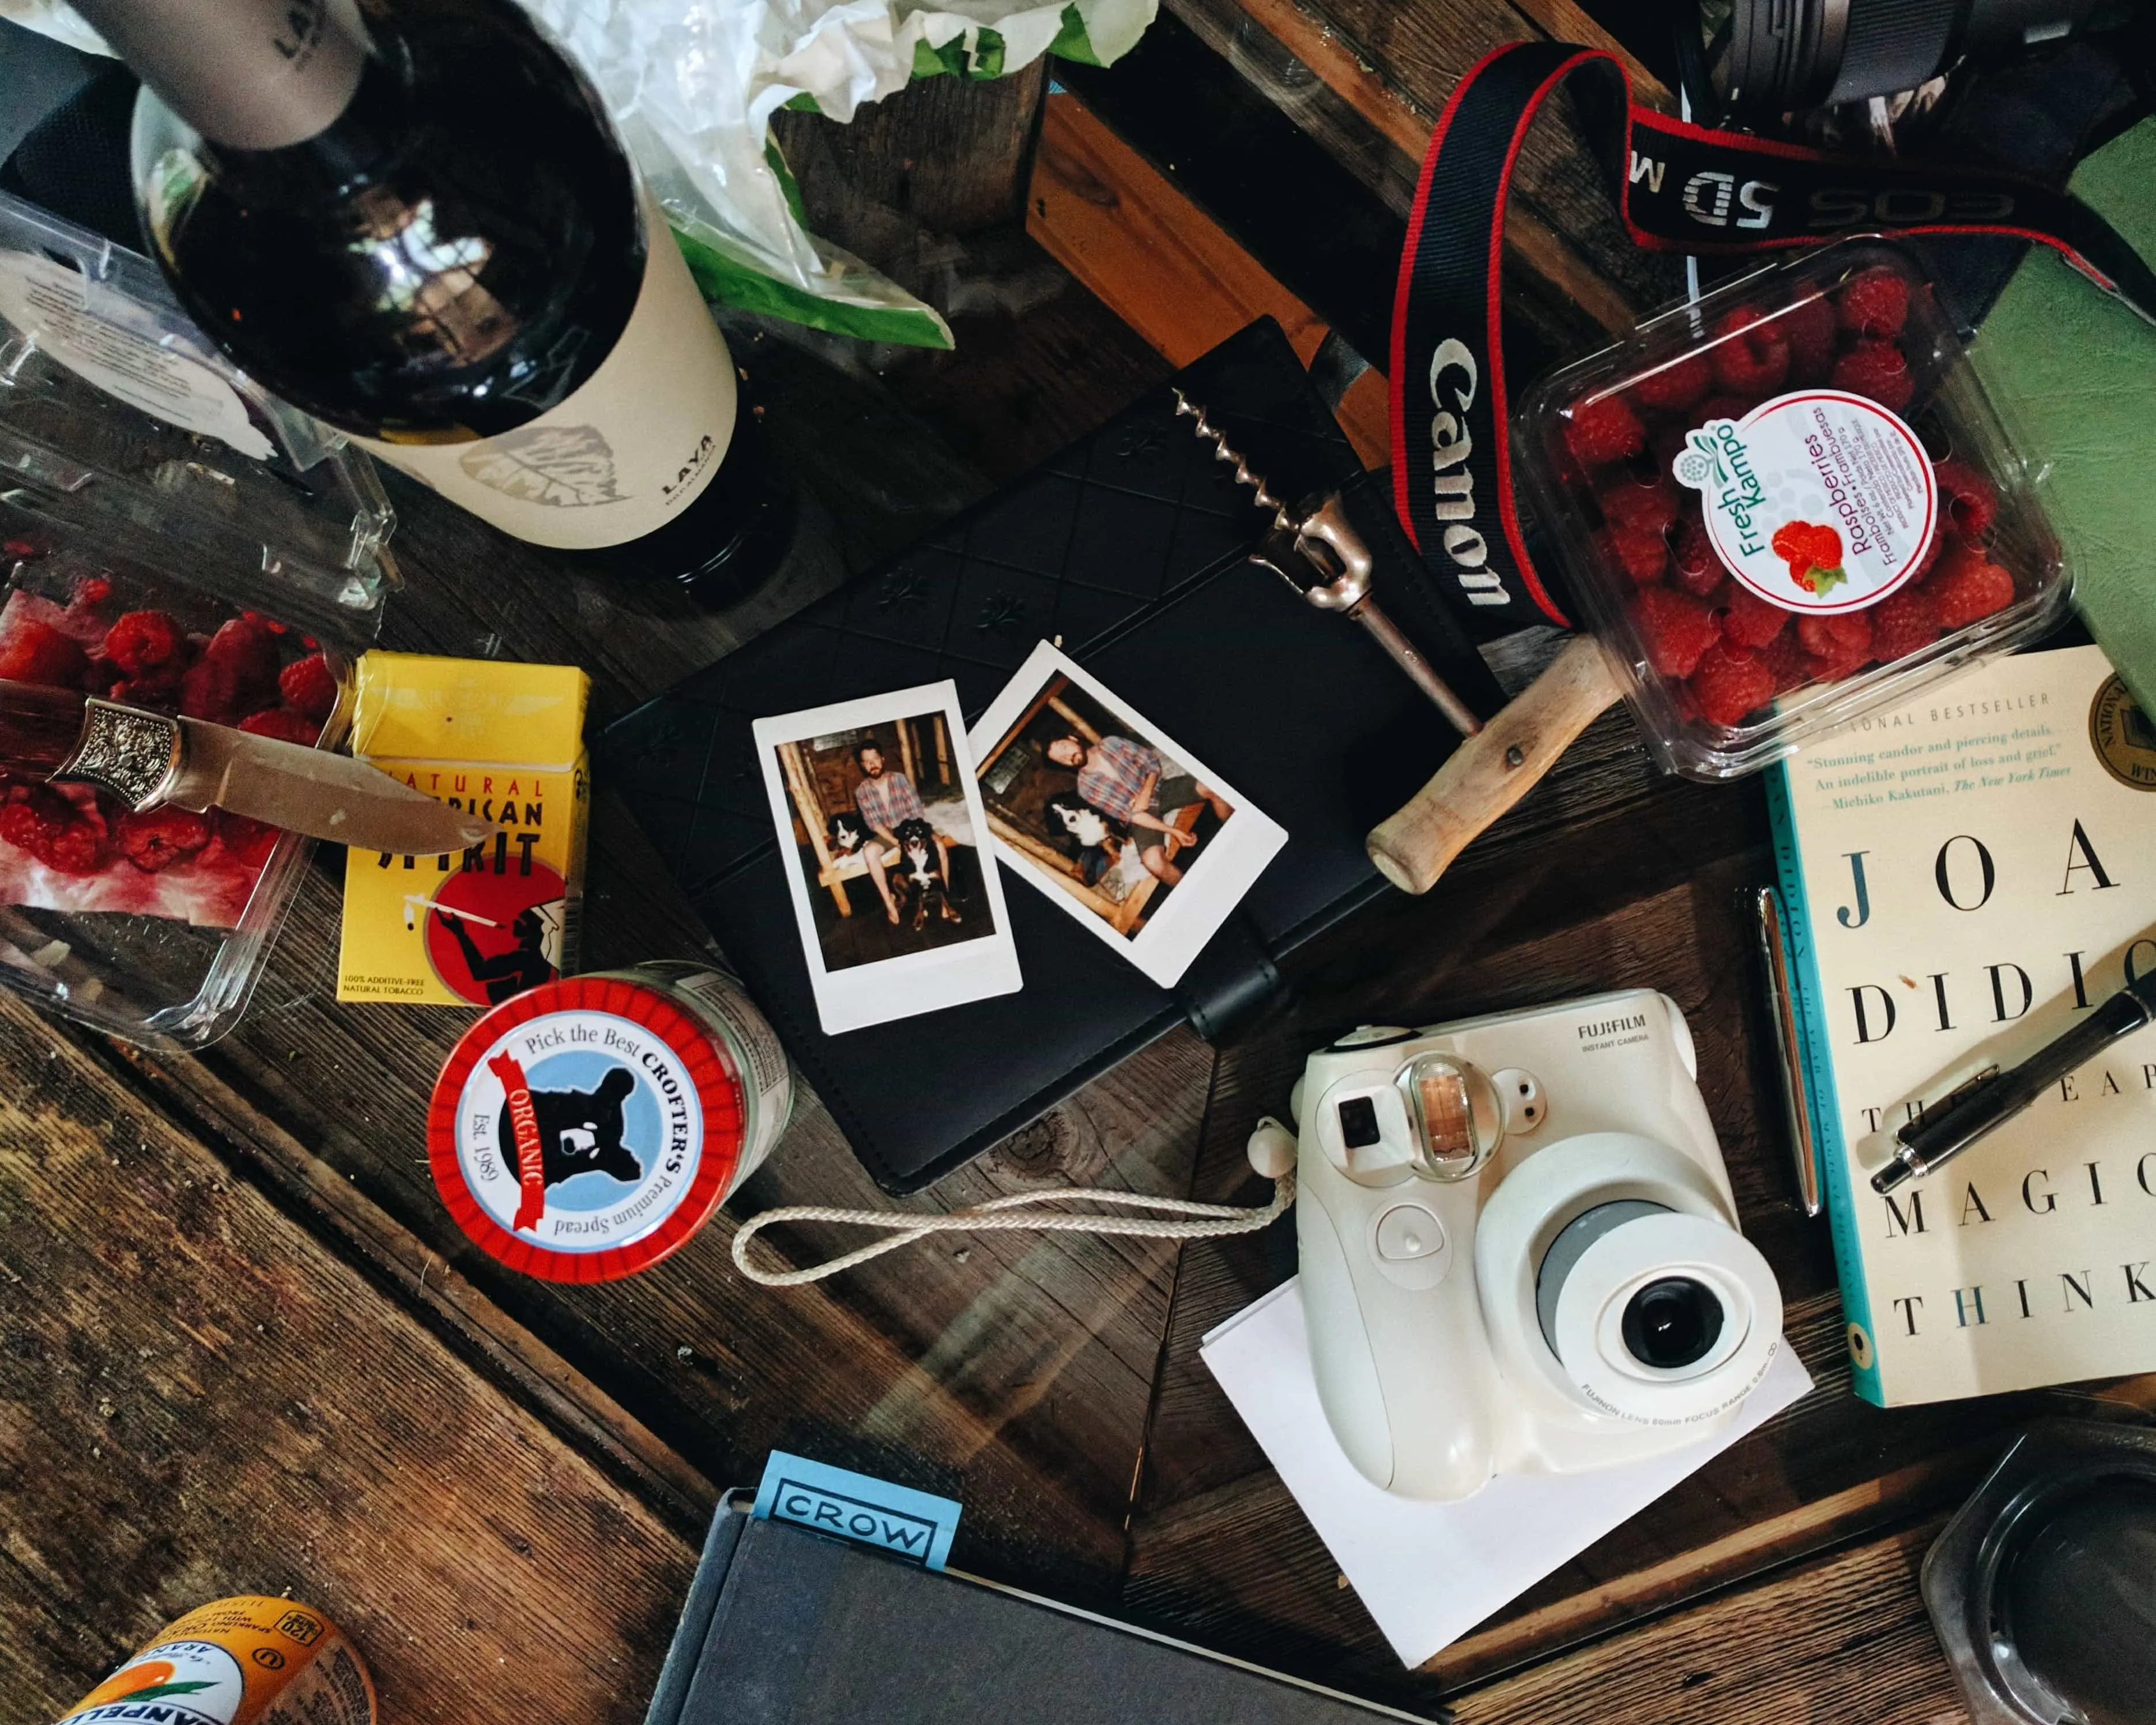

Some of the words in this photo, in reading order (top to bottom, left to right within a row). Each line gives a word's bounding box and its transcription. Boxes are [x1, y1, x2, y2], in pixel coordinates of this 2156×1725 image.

[1683, 171, 1780, 229] 5D
[662, 434, 713, 495] LAYA
[1813, 407, 1855, 487] Frambuesas
[1430, 337, 1511, 605] Canon
[1717, 424, 1767, 511] Kampo
[1804, 434, 1872, 556] Raspberries
[1717, 488, 1766, 557] Fresh
[1855, 494, 1897, 566] Framboises
[1930, 692, 2051, 722] BESTSELLER
[1879, 744, 1923, 760] candor
[1927, 739, 1952, 753] and
[1955, 732, 2008, 752] piercing
[388, 770, 542, 797] ATURAL
[1815, 779, 1833, 792] An
[1838, 771, 1895, 787] indelible
[1901, 763, 1949, 781] portrait
[1953, 759, 1967, 771] of
[1970, 754, 1995, 766] loss
[1999, 748, 2022, 762] and
[1889, 784, 1950, 802] Kakutani,
[1954, 779, 1976, 792] The
[1980, 775, 2003, 788] New
[2008, 771, 2036, 784] York
[2038, 766, 2072, 779] Times
[431, 796, 543, 826] ICAN
[378, 833, 541, 876] RIT
[343, 985, 380, 993] NATURAL
[384, 986, 424, 996] TOBACCO
[344, 974, 365, 984] 100%
[367, 976, 425, 986] ADDITIVE-FREE
[524, 1027, 566, 1055] Pick
[570, 1023, 598, 1042] the
[601, 1027, 642, 1059] Best
[1577, 1014, 1646, 1039] FUJIFILM
[1582, 1039, 1616, 1053] INSTANT
[1617, 1033, 1649, 1046] CAMERA
[473, 1113, 491, 1142] Est.
[640, 1051, 688, 1175] CROFTER'S
[509, 1087, 544, 1188] ORGANIC
[473, 1144, 500, 1183] 1989
[612, 1173, 672, 1227] Premium
[554, 1216, 610, 1236] Spread
[1581, 1383, 1621, 1417] FUJINON
[1621, 1410, 1649, 1425] LENS
[1652, 1418, 1682, 1426] 60mm
[1684, 1407, 1720, 1424] FOCUS
[1721, 1384, 1752, 1410] RANGE
[785, 1494, 925, 1550] CROW
[281, 1621, 308, 1641] 120
